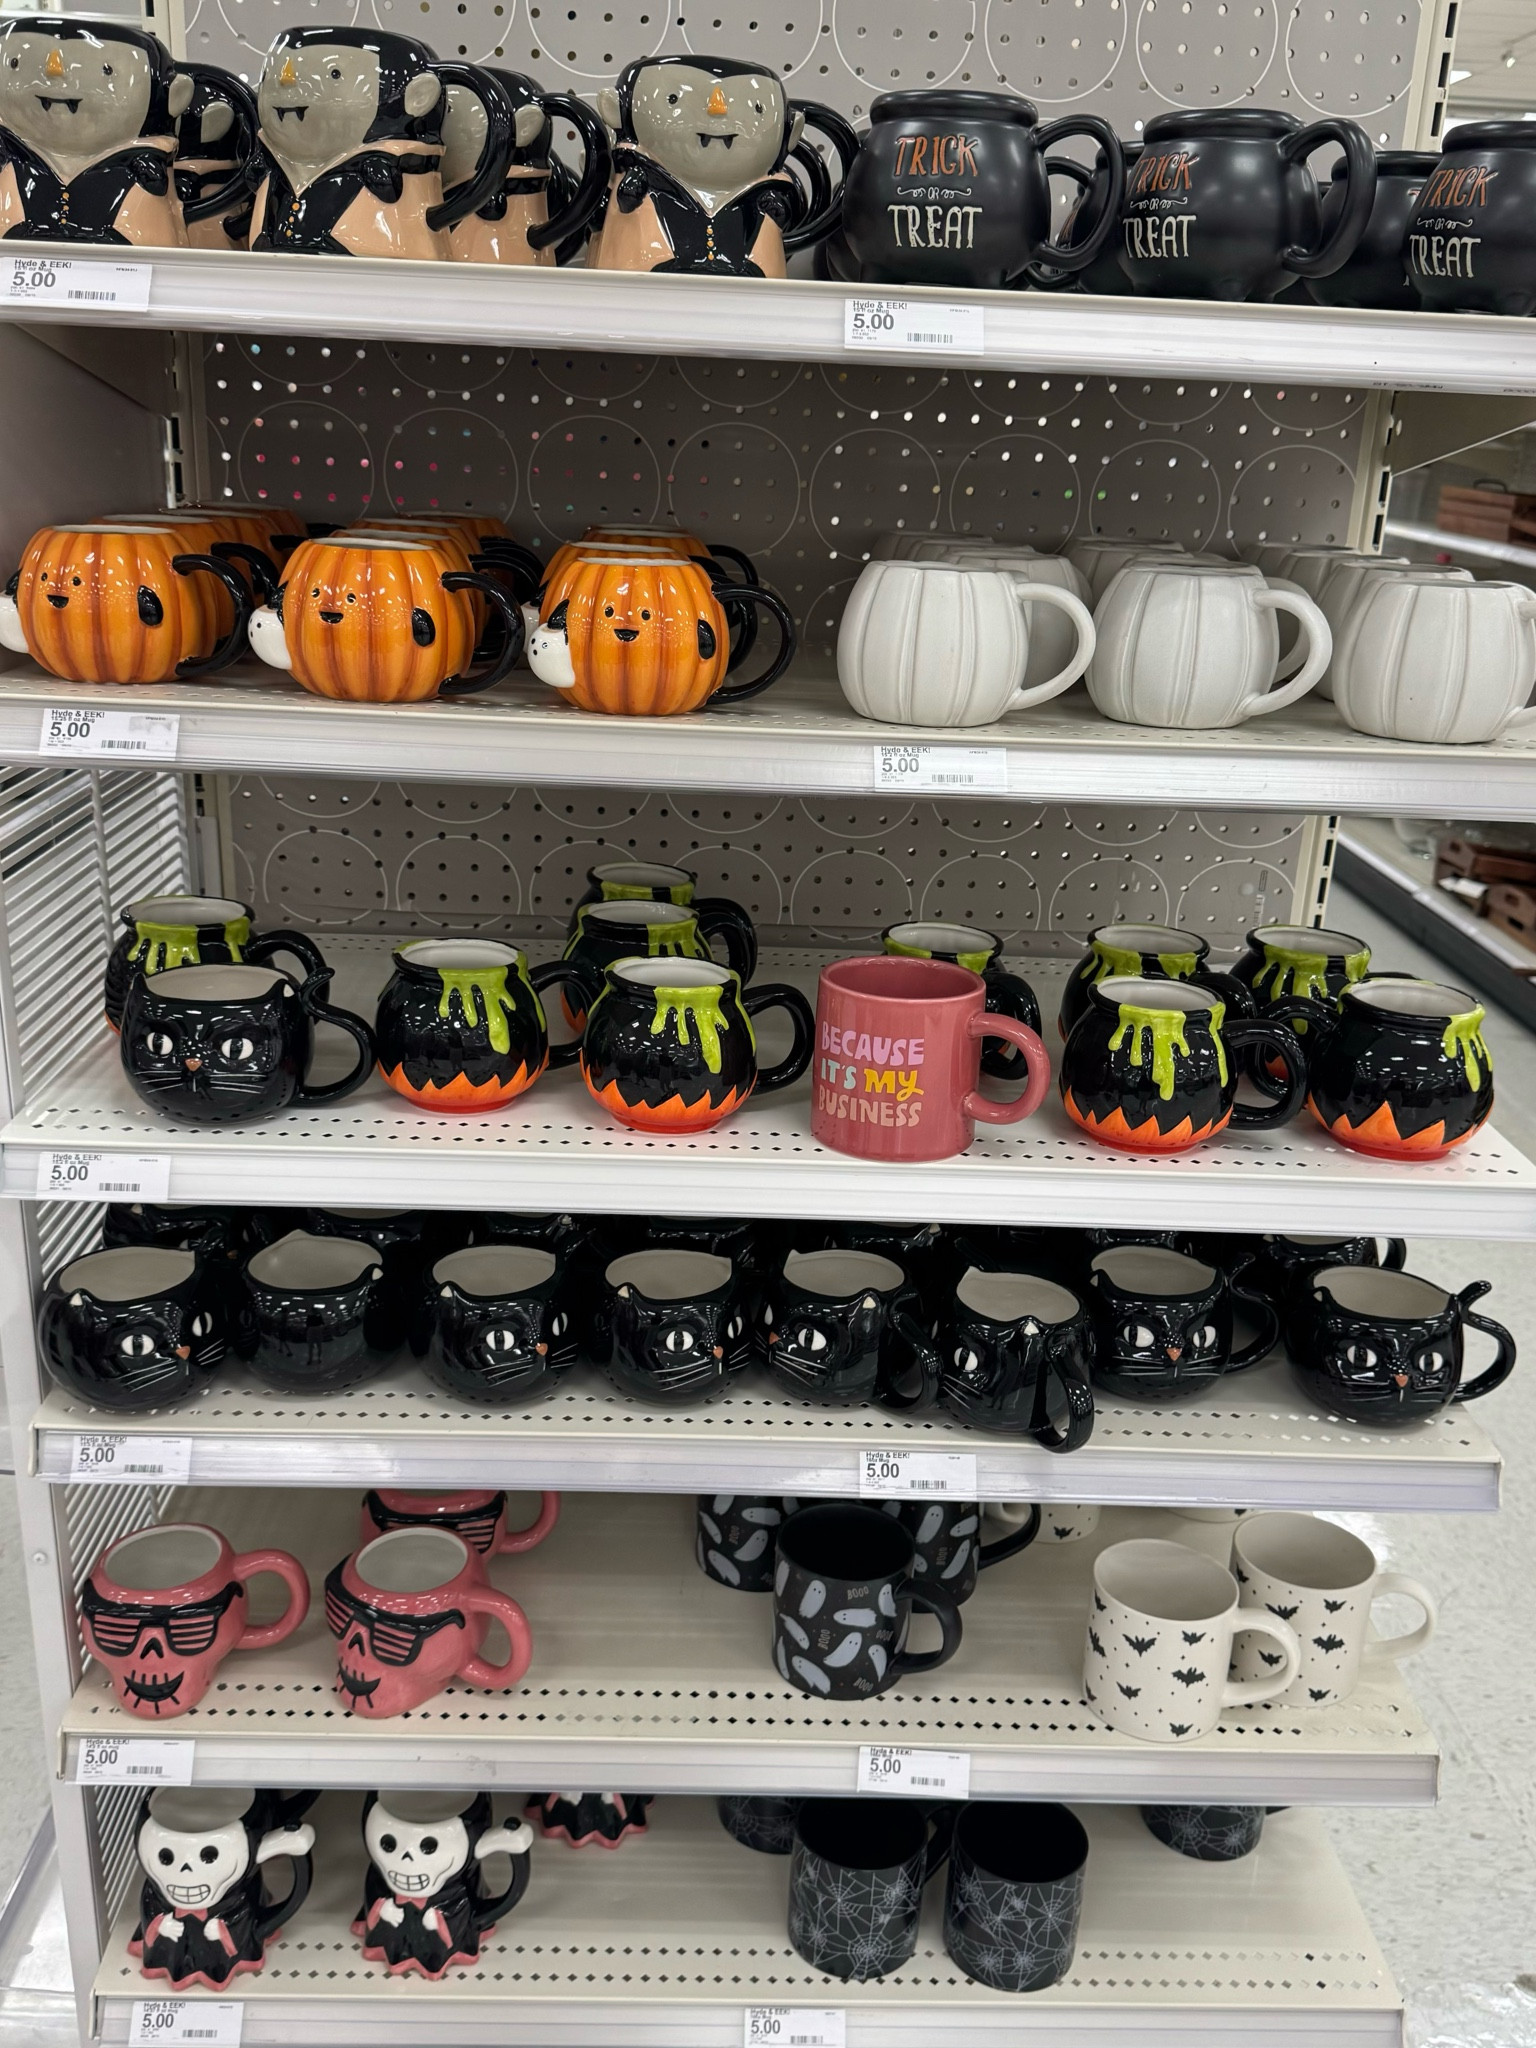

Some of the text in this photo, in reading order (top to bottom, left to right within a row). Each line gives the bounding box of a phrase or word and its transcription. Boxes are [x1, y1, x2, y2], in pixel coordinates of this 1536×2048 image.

[895, 136, 978, 176] TRICK
[1128, 153, 1200, 193] TRICK
[927, 187, 940, 200] OR
[1421, 166, 1499, 207] TRICK
[1150, 198, 1159, 211] OR
[887, 205, 983, 249] TREAT
[1434, 218, 1445, 230] OR
[1122, 215, 1197, 259] TREAT
[14, 259, 37, 268] Hyde
[50, 261, 72, 269] EEK!
[1409, 234, 1482, 278] TREAT
[12, 272, 56, 288] 5.00
[853, 300, 908, 310] Hyde & EEK!
[853, 313, 895, 330] 5.00
[51, 709, 73, 719] Hyde
[50, 722, 91, 738] 5.00
[881, 746, 901, 755] Hyde
[882, 758, 920, 773] 5.00
[822, 1021, 925, 1067] BECAUSE
[821, 1058, 857, 1090] IT'S
[818, 1085, 922, 1127] BUSINESS
[52, 1153, 72, 1161] Hyde
[51, 1165, 89, 1181] 5.00
[80, 1448, 115, 1463] 5.00
[866, 1463, 900, 1478] 5.00
[847, 1585, 870, 1601] BOOO
[85, 1750, 118, 1764] 5.00
[870, 1758, 901, 1774] 5.00
[142, 2014, 175, 2028] 5.00
[751, 2020, 781, 2034] 5.00
